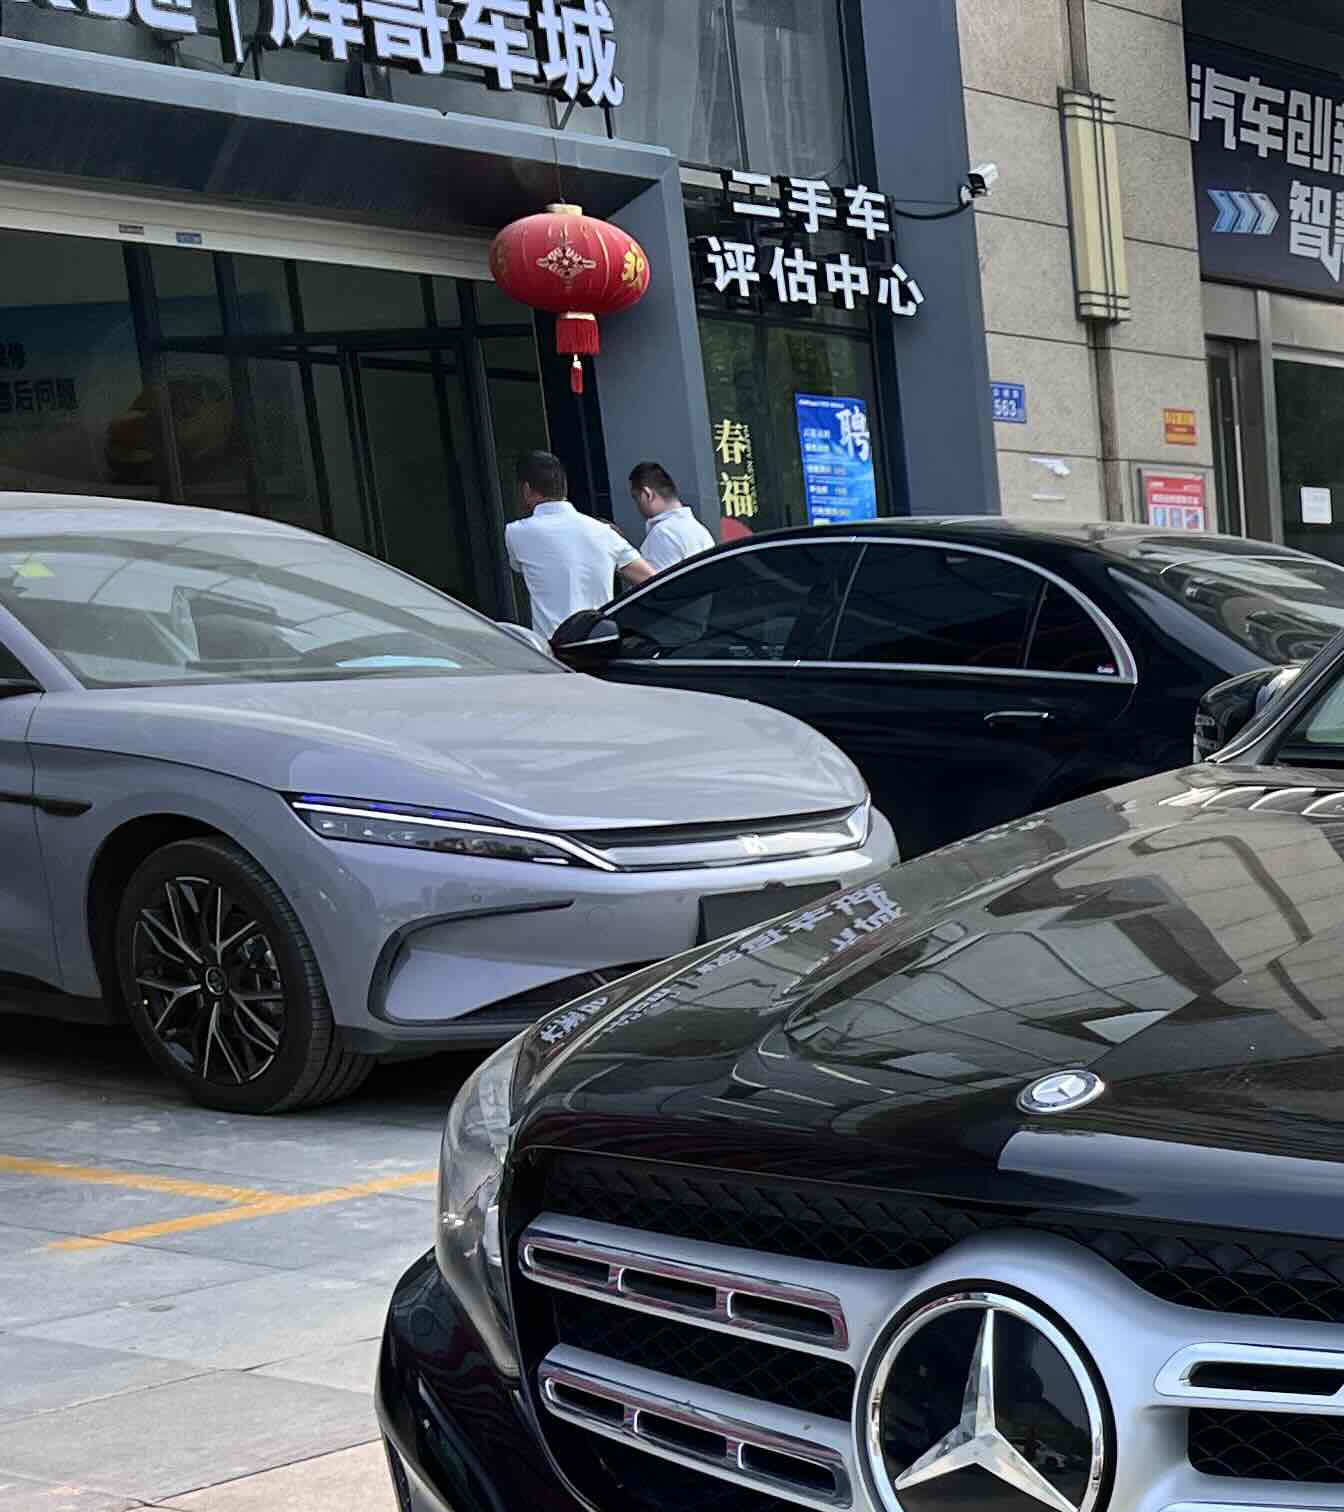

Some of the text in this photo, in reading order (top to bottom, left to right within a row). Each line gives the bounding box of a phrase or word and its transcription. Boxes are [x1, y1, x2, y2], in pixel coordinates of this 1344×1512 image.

[731, 169, 890, 240] 二手车
[707, 236, 925, 316] 评估中心
[836, 404, 871, 462] 聘
